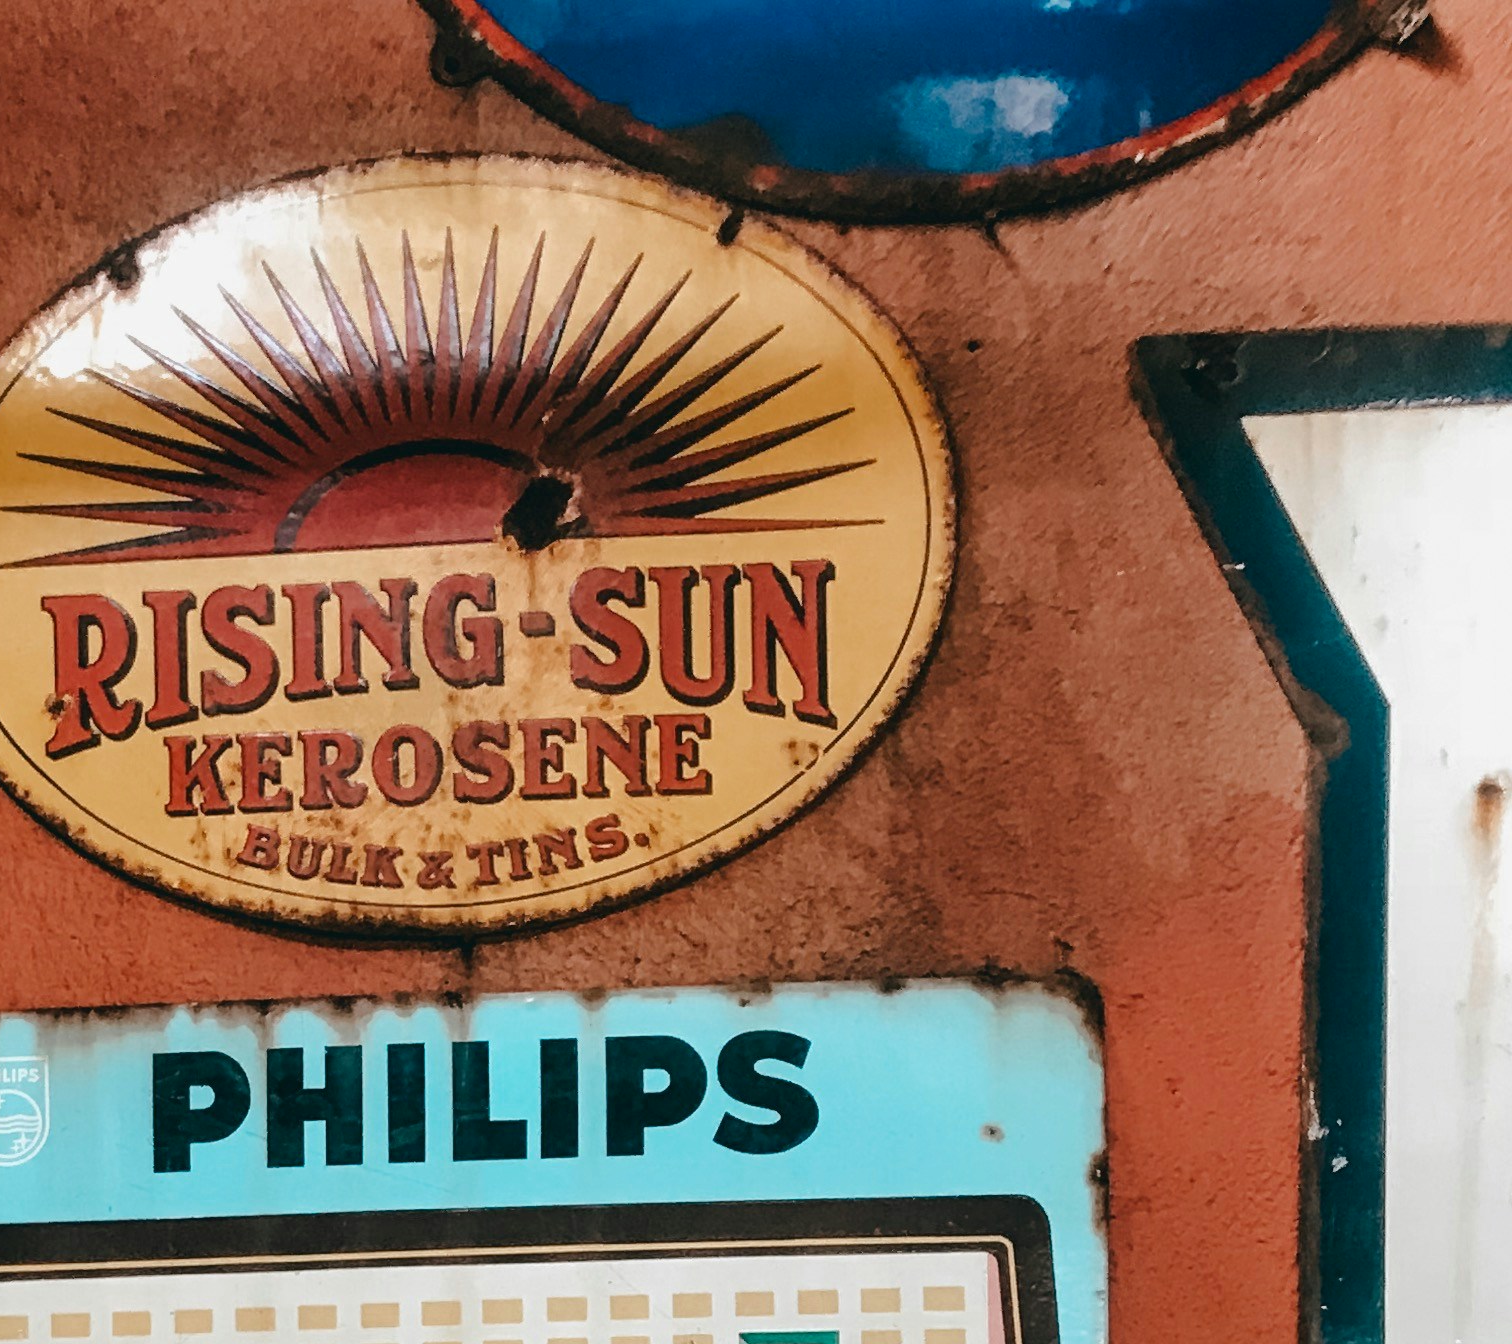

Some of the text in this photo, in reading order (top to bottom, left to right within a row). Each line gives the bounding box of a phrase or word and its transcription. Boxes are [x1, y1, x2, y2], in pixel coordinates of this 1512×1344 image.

[40, 558, 838, 761] RISING-SUN
[163, 713, 713, 817] KEROSENE
[235, 822, 405, 889] BULK
[417, 849, 458, 890] &
[150, 1028, 821, 1175] PHILIPS
